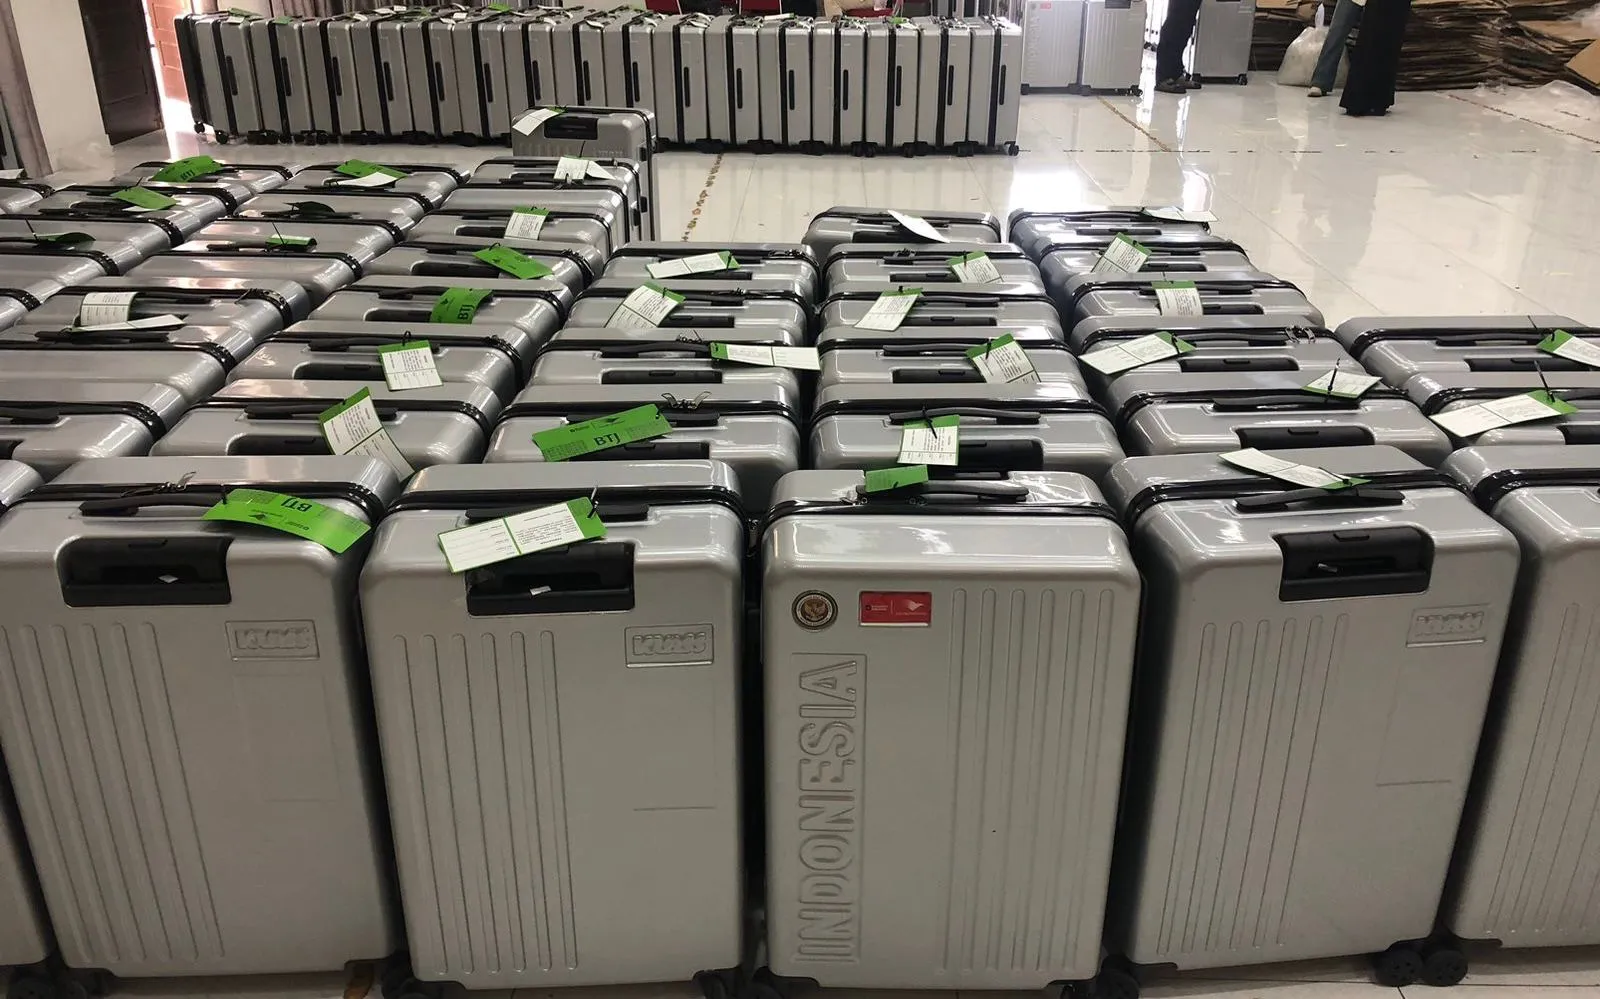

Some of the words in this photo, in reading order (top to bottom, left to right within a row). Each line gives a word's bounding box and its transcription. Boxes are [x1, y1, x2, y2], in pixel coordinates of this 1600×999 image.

[457, 304, 475, 320] BTJ
[593, 432, 622, 446] BTJ
[280, 497, 312, 512] BTJ
[798, 660, 857, 960] INDONESIA
